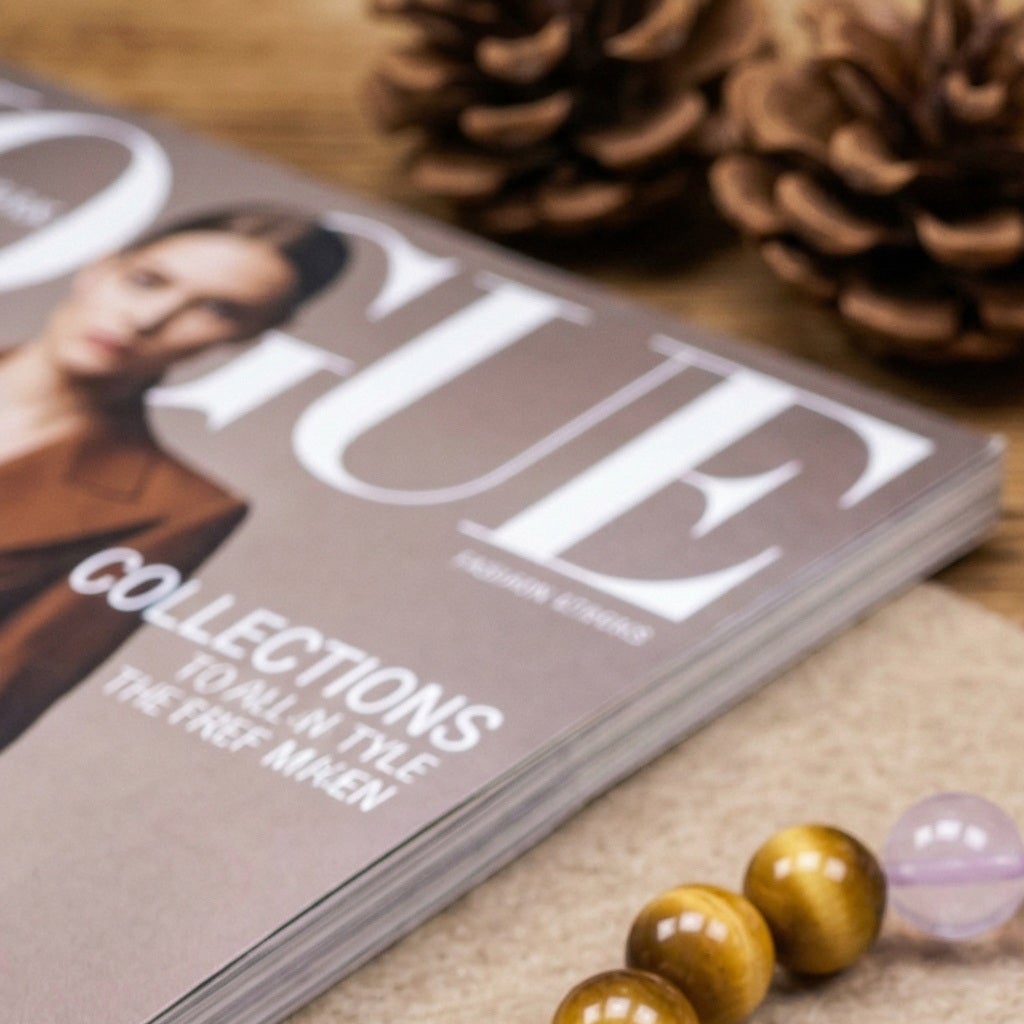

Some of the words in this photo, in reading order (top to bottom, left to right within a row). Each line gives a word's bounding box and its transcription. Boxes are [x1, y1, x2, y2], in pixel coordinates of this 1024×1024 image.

[0, 80, 936, 623] OGUE
[68, 546, 504, 753] COLLECTIONS
[102, 663, 186, 718] THE
[337, 721, 441, 785] TYLE
